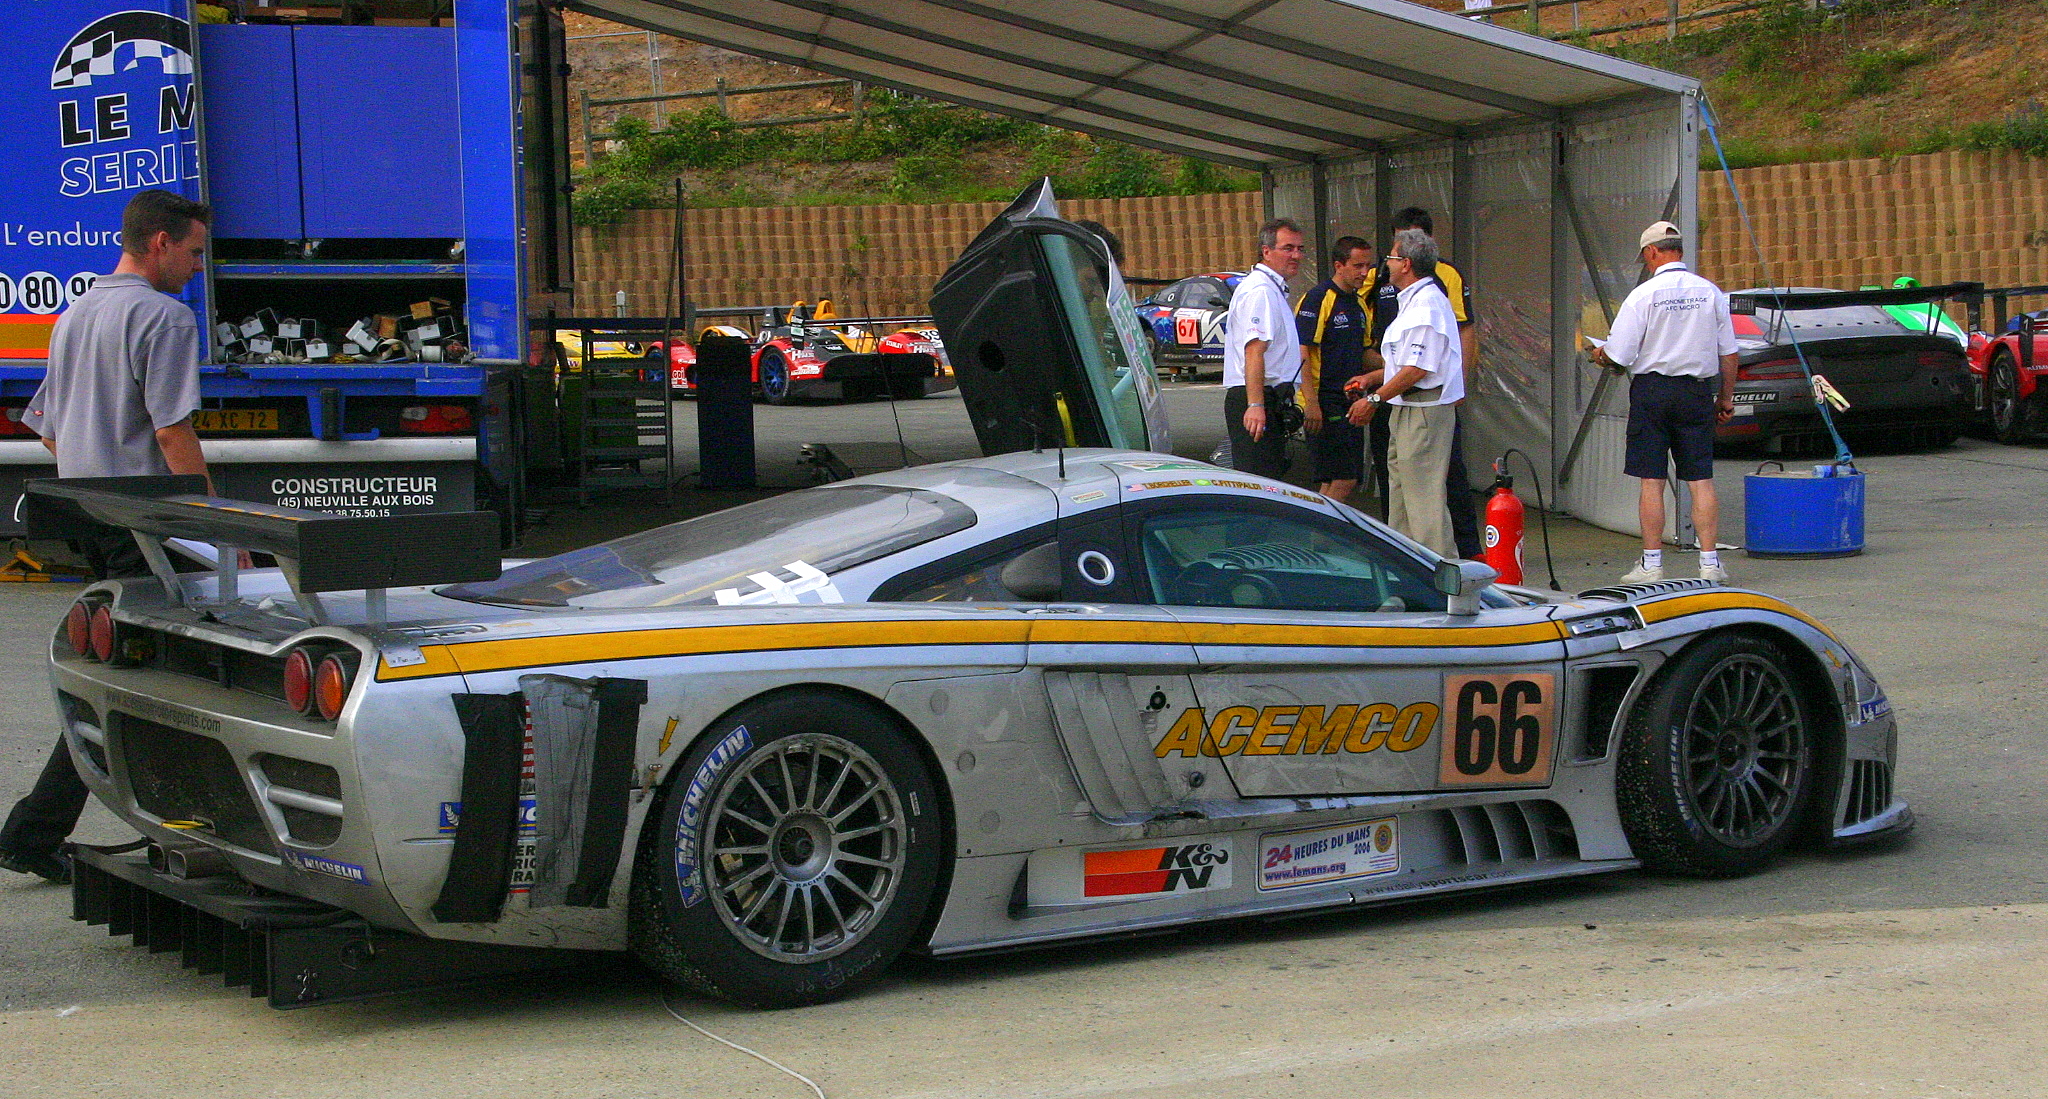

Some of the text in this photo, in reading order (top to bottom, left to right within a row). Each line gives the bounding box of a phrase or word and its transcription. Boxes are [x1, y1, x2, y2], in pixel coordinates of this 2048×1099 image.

[59, 93, 130, 148] LE
[25, 276, 58, 308] 80
[1178, 319, 1196, 338] 67
[1731, 393, 1776, 403] ICHELIN
[220, 411, 239, 429] XC
[247, 411, 268, 429] 72
[271, 477, 437, 495] CONSTRUCTEUR
[277, 495, 434, 509] (45) NEUVILLE AUX BOIS
[1154, 680, 1542, 775] ACEMCO 66
[678, 730, 746, 865] MICHELIN
[1264, 825, 1371, 869] 24 HEURES DU MANS
[1354, 841, 1371, 855] 2006
[304, 857, 363, 880] MICHELIN
[1264, 861, 1347, 882] www.lemans.org
